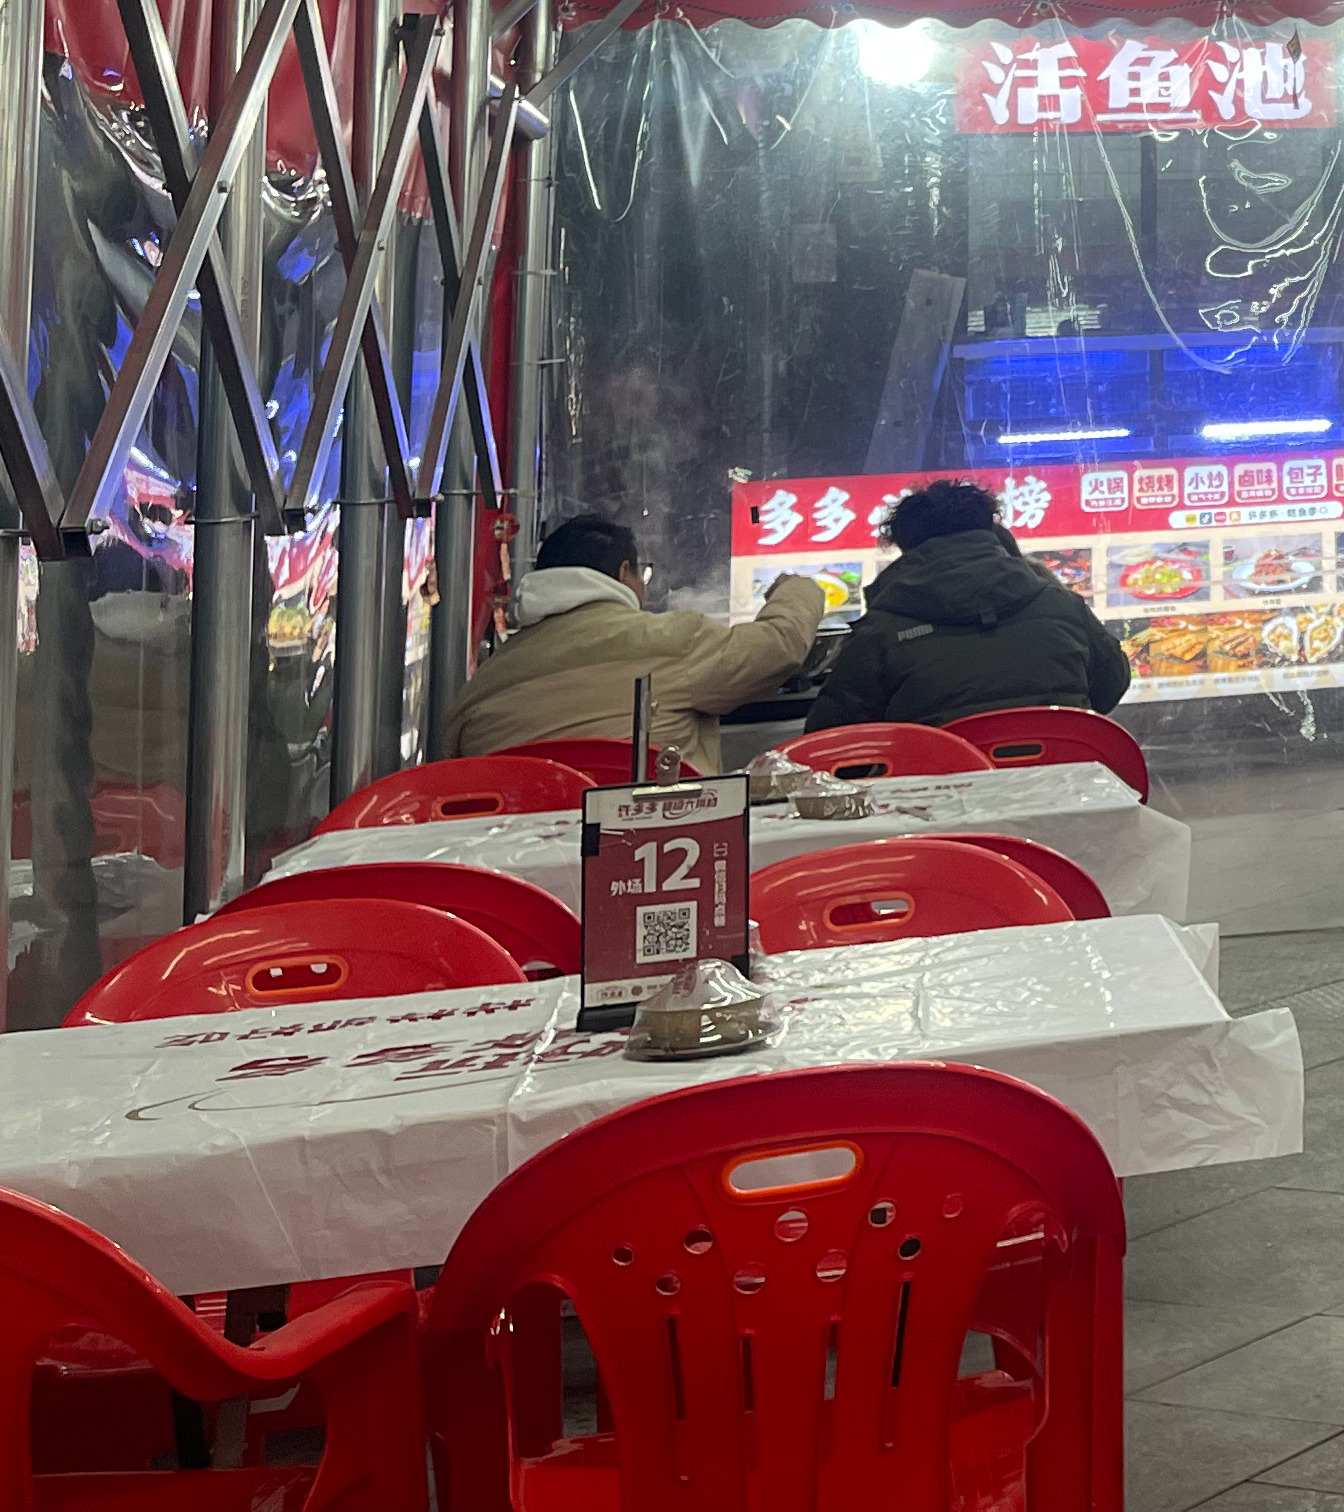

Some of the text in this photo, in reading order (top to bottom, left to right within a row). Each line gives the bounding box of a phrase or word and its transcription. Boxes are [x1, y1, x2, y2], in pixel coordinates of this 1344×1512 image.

[982, 39, 1312, 125] 活鱼池
[1188, 471, 1225, 490] 小炒
[1239, 469, 1274, 487] 卤味
[1287, 465, 1323, 483] 包子
[757, 476, 1051, 545] 多多榜
[634, 837, 701, 893] 12
